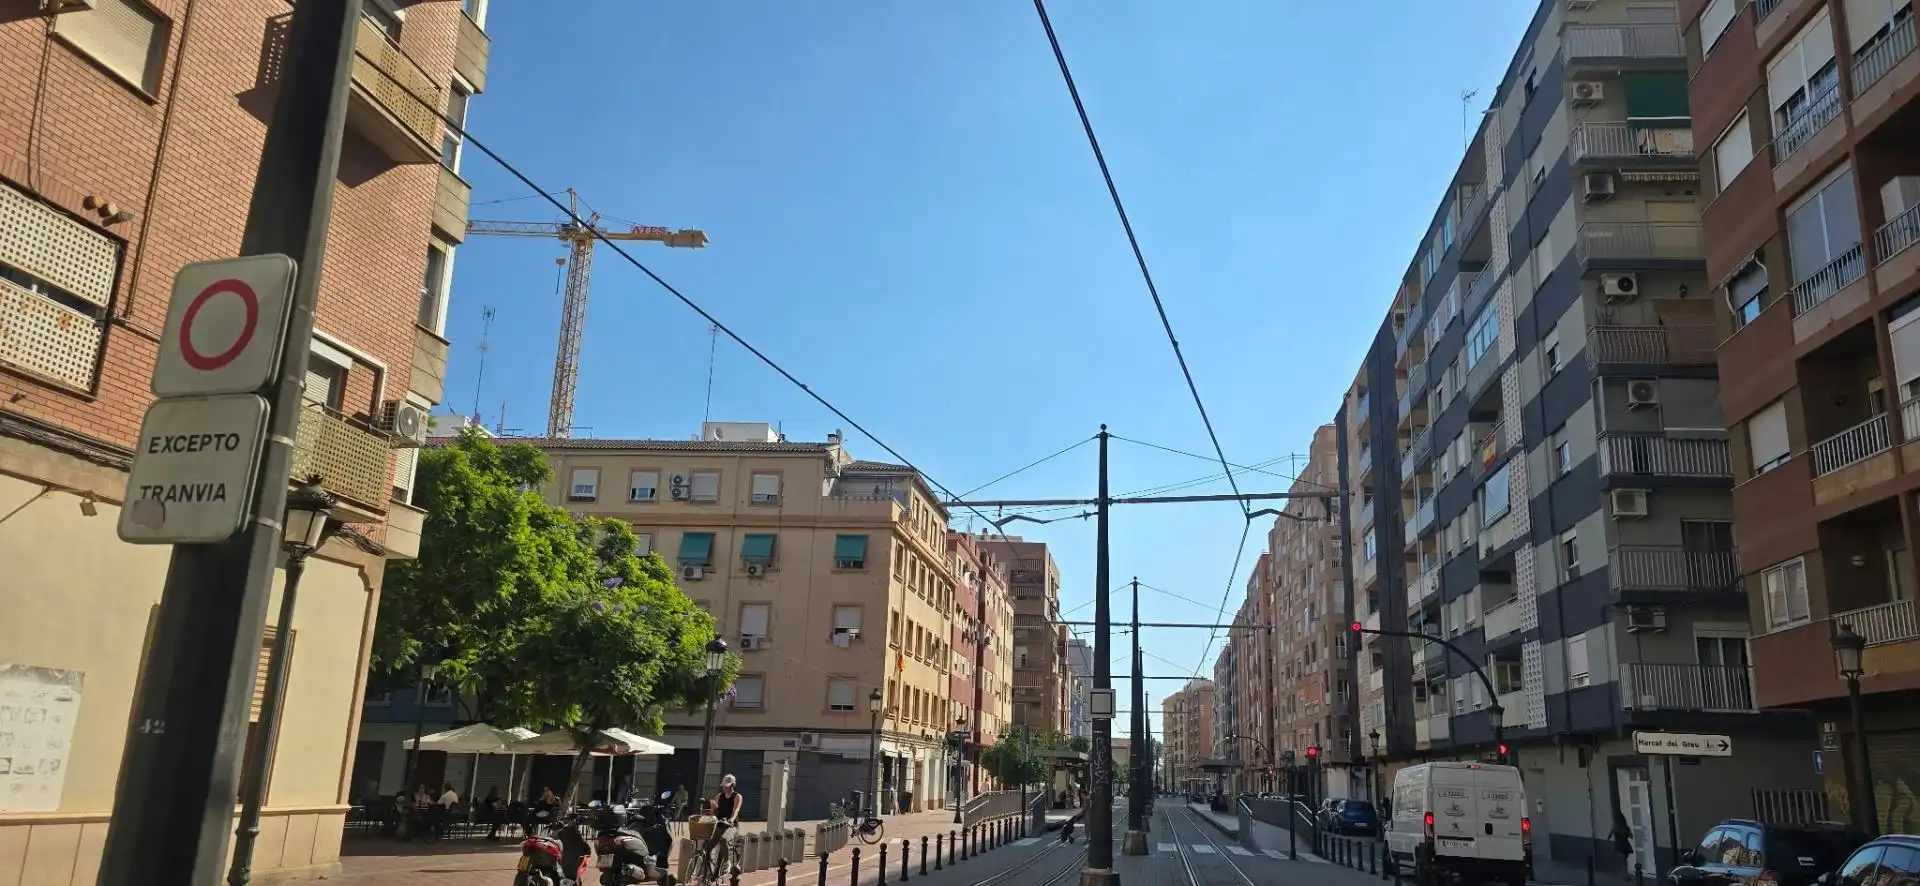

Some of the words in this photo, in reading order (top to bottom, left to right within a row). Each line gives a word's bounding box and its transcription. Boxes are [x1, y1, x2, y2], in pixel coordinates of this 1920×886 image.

[148, 433, 240, 454] EXCEPTO
[140, 483, 227, 504] TRANVIA
[1638, 739, 1662, 747] Mercat
